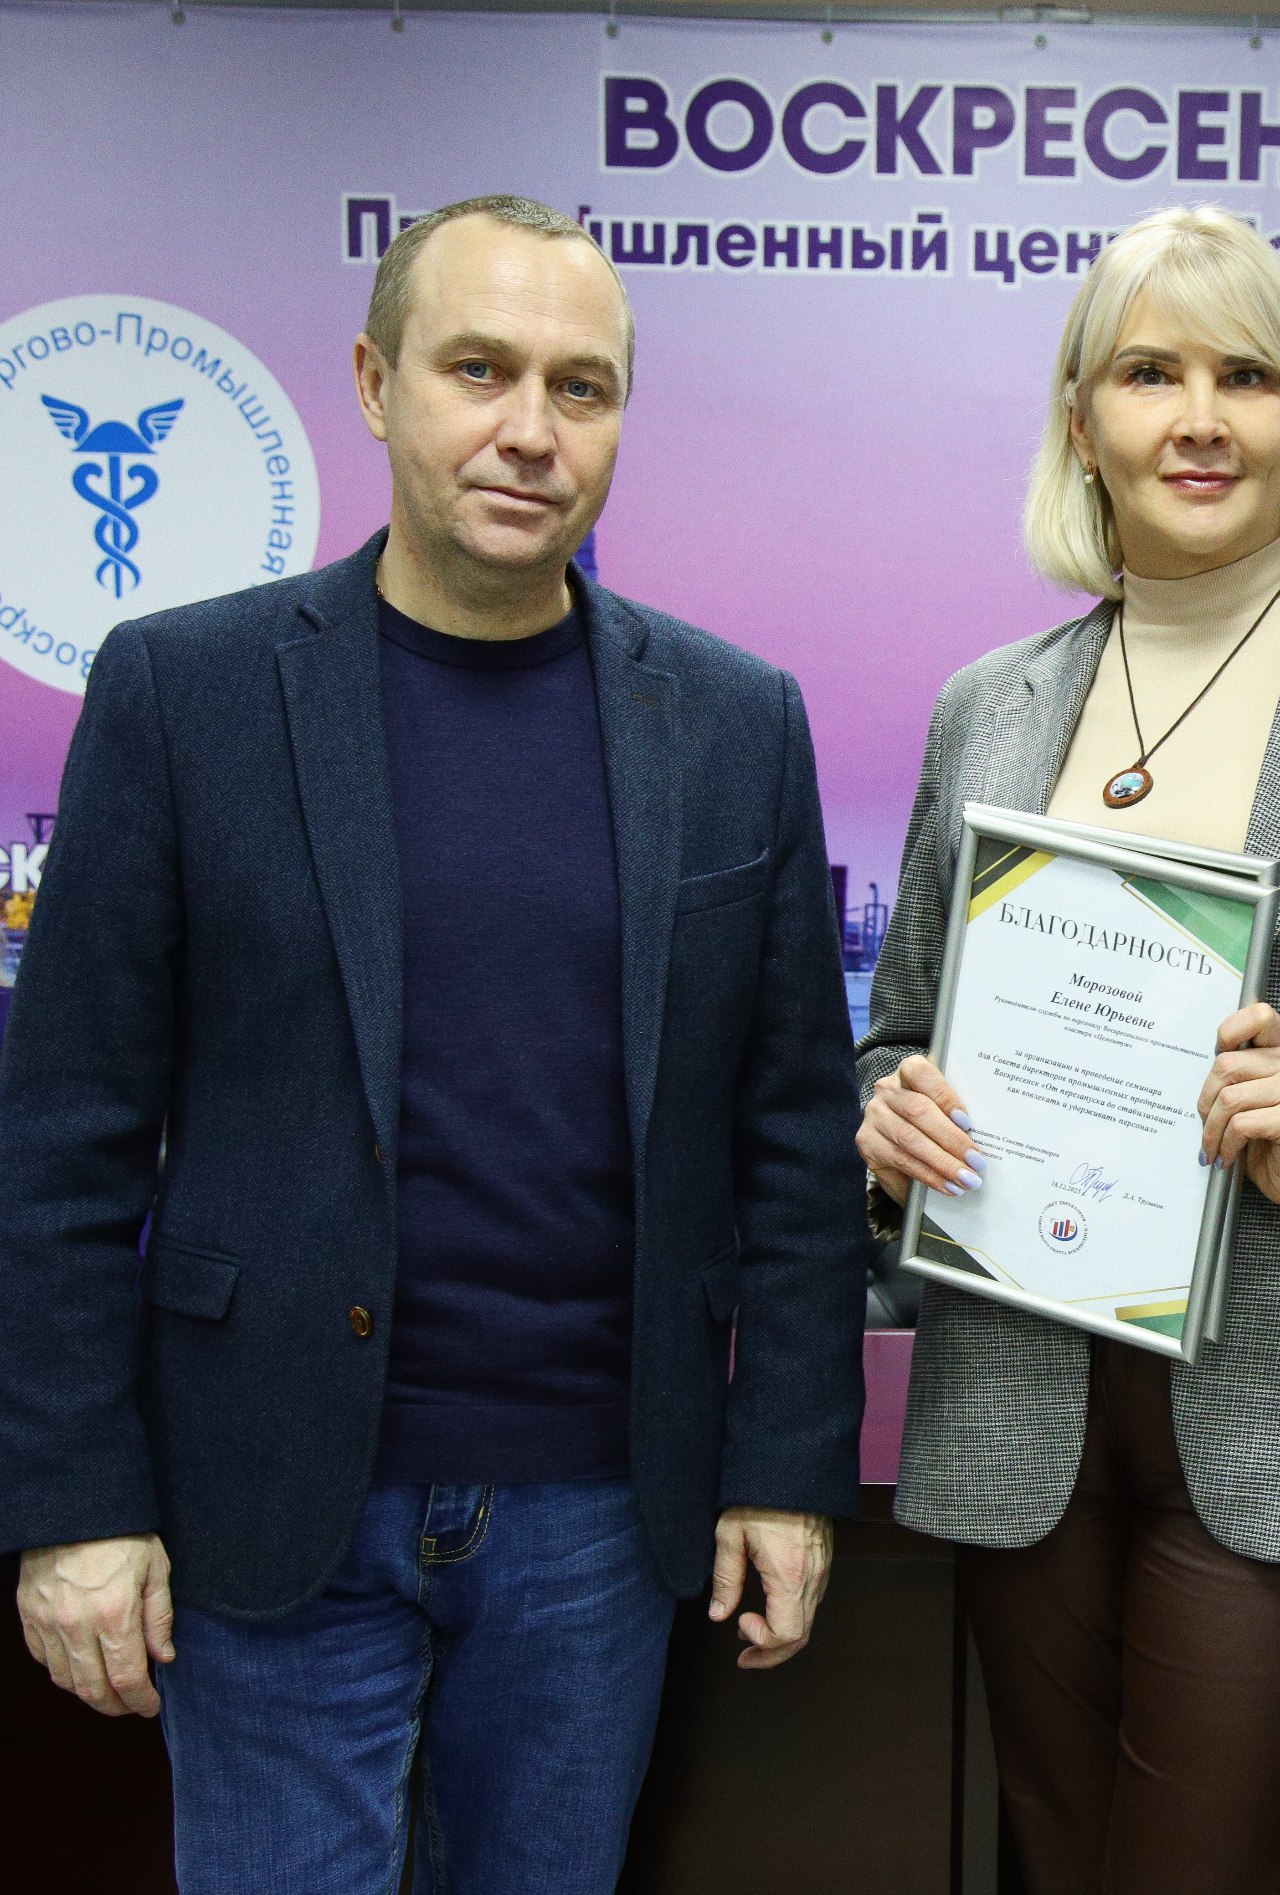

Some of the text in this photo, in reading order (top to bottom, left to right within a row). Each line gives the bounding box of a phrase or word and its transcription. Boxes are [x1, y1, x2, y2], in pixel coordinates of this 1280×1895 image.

[347, 198, 949, 272] Пшленный
[973, 228, 1116, 283] цен
[0, 313, 295, 576] ргово-Промышленная
[1000, 901, 1212, 976] БЛАГОДАРНОСТЬ
[1051, 991, 1155, 1030] Елене Юрьевне
[1069, 973, 1143, 1003] Морозовой
[978, 1051, 991, 1060] для
[993, 1054, 1020, 1069] Совета
[1022, 1061, 1067, 1082] директоров
[1068, 1076, 1128, 1099] промышленных
[1129, 1092, 1183, 1115] предприятий
[993, 1068, 1177, 1126] Воскресенск «От перезапуска до стабилизации:
[1024, 1053, 1072, 1071] организацию
[1081, 1067, 1124, 1086] проведение
[1125, 1080, 1162, 1096] семинара
[1007, 1085, 1020, 1095] как
[1021, 1089, 1061, 1106] вовлекать
[1068, 1103, 1116, 1122] удерживать
[1118, 1117, 1158, 1134] персонал»
